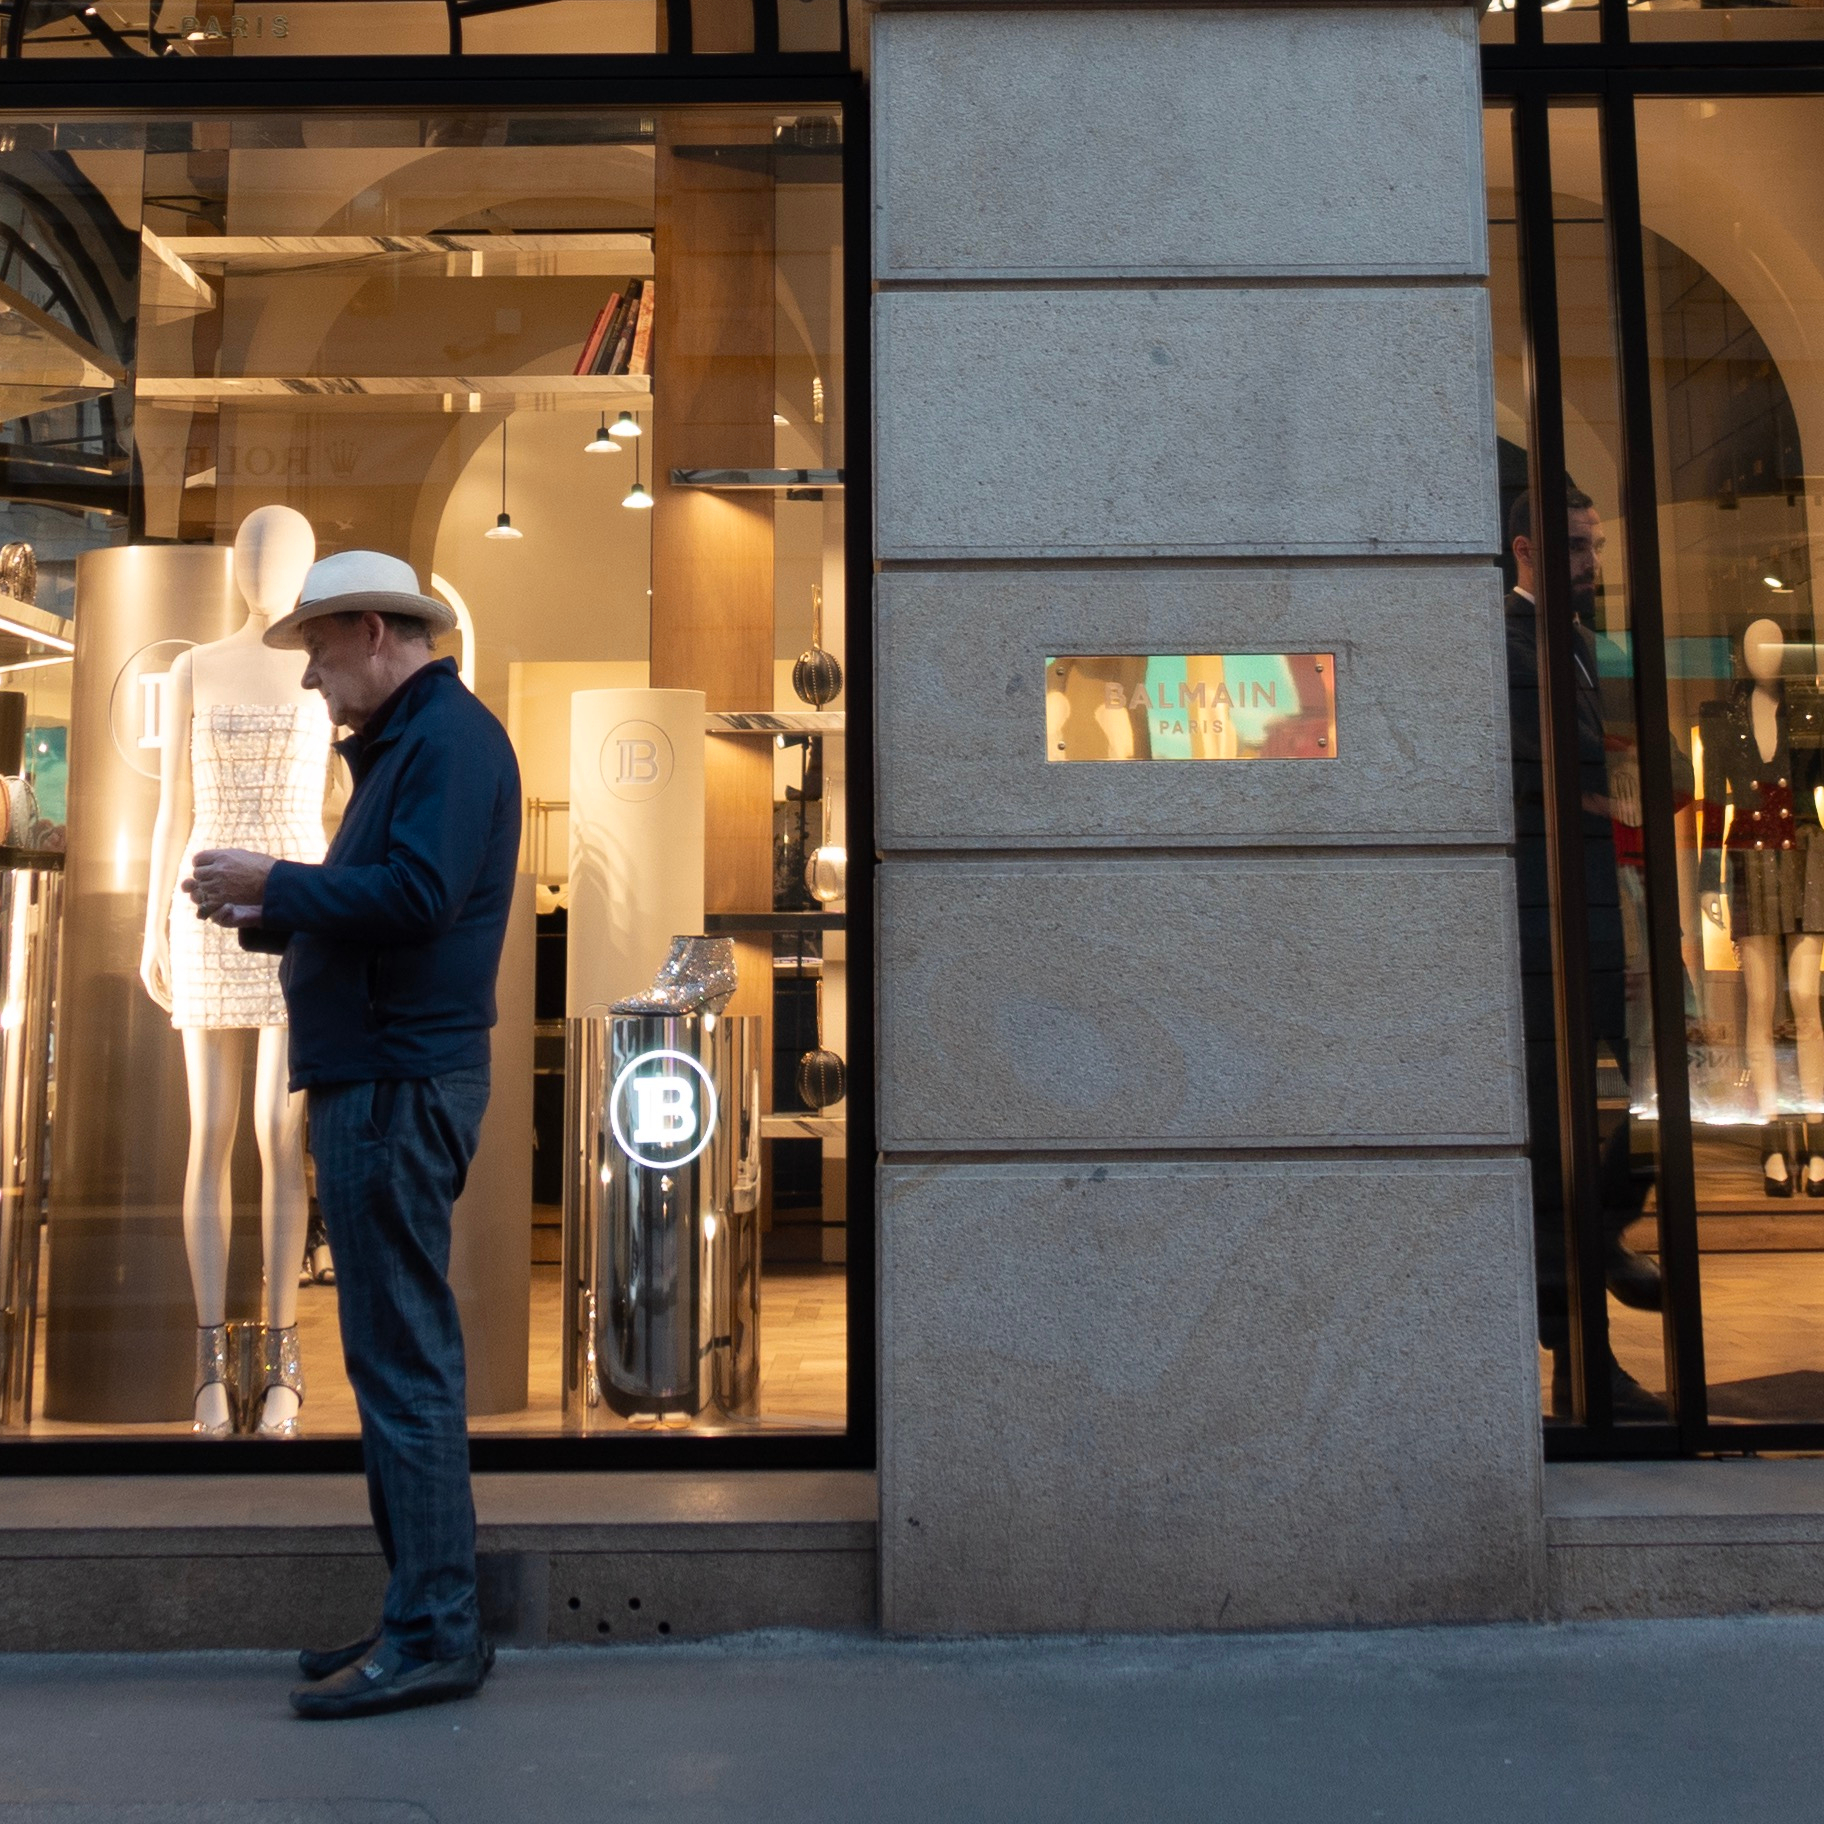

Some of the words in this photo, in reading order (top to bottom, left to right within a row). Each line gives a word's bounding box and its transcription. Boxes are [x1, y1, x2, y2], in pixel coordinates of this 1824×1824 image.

[180, 14, 290, 39] PARIS
[1103, 680, 1277, 710] BALMAIN
[1158, 719, 1225, 736] PARIS
